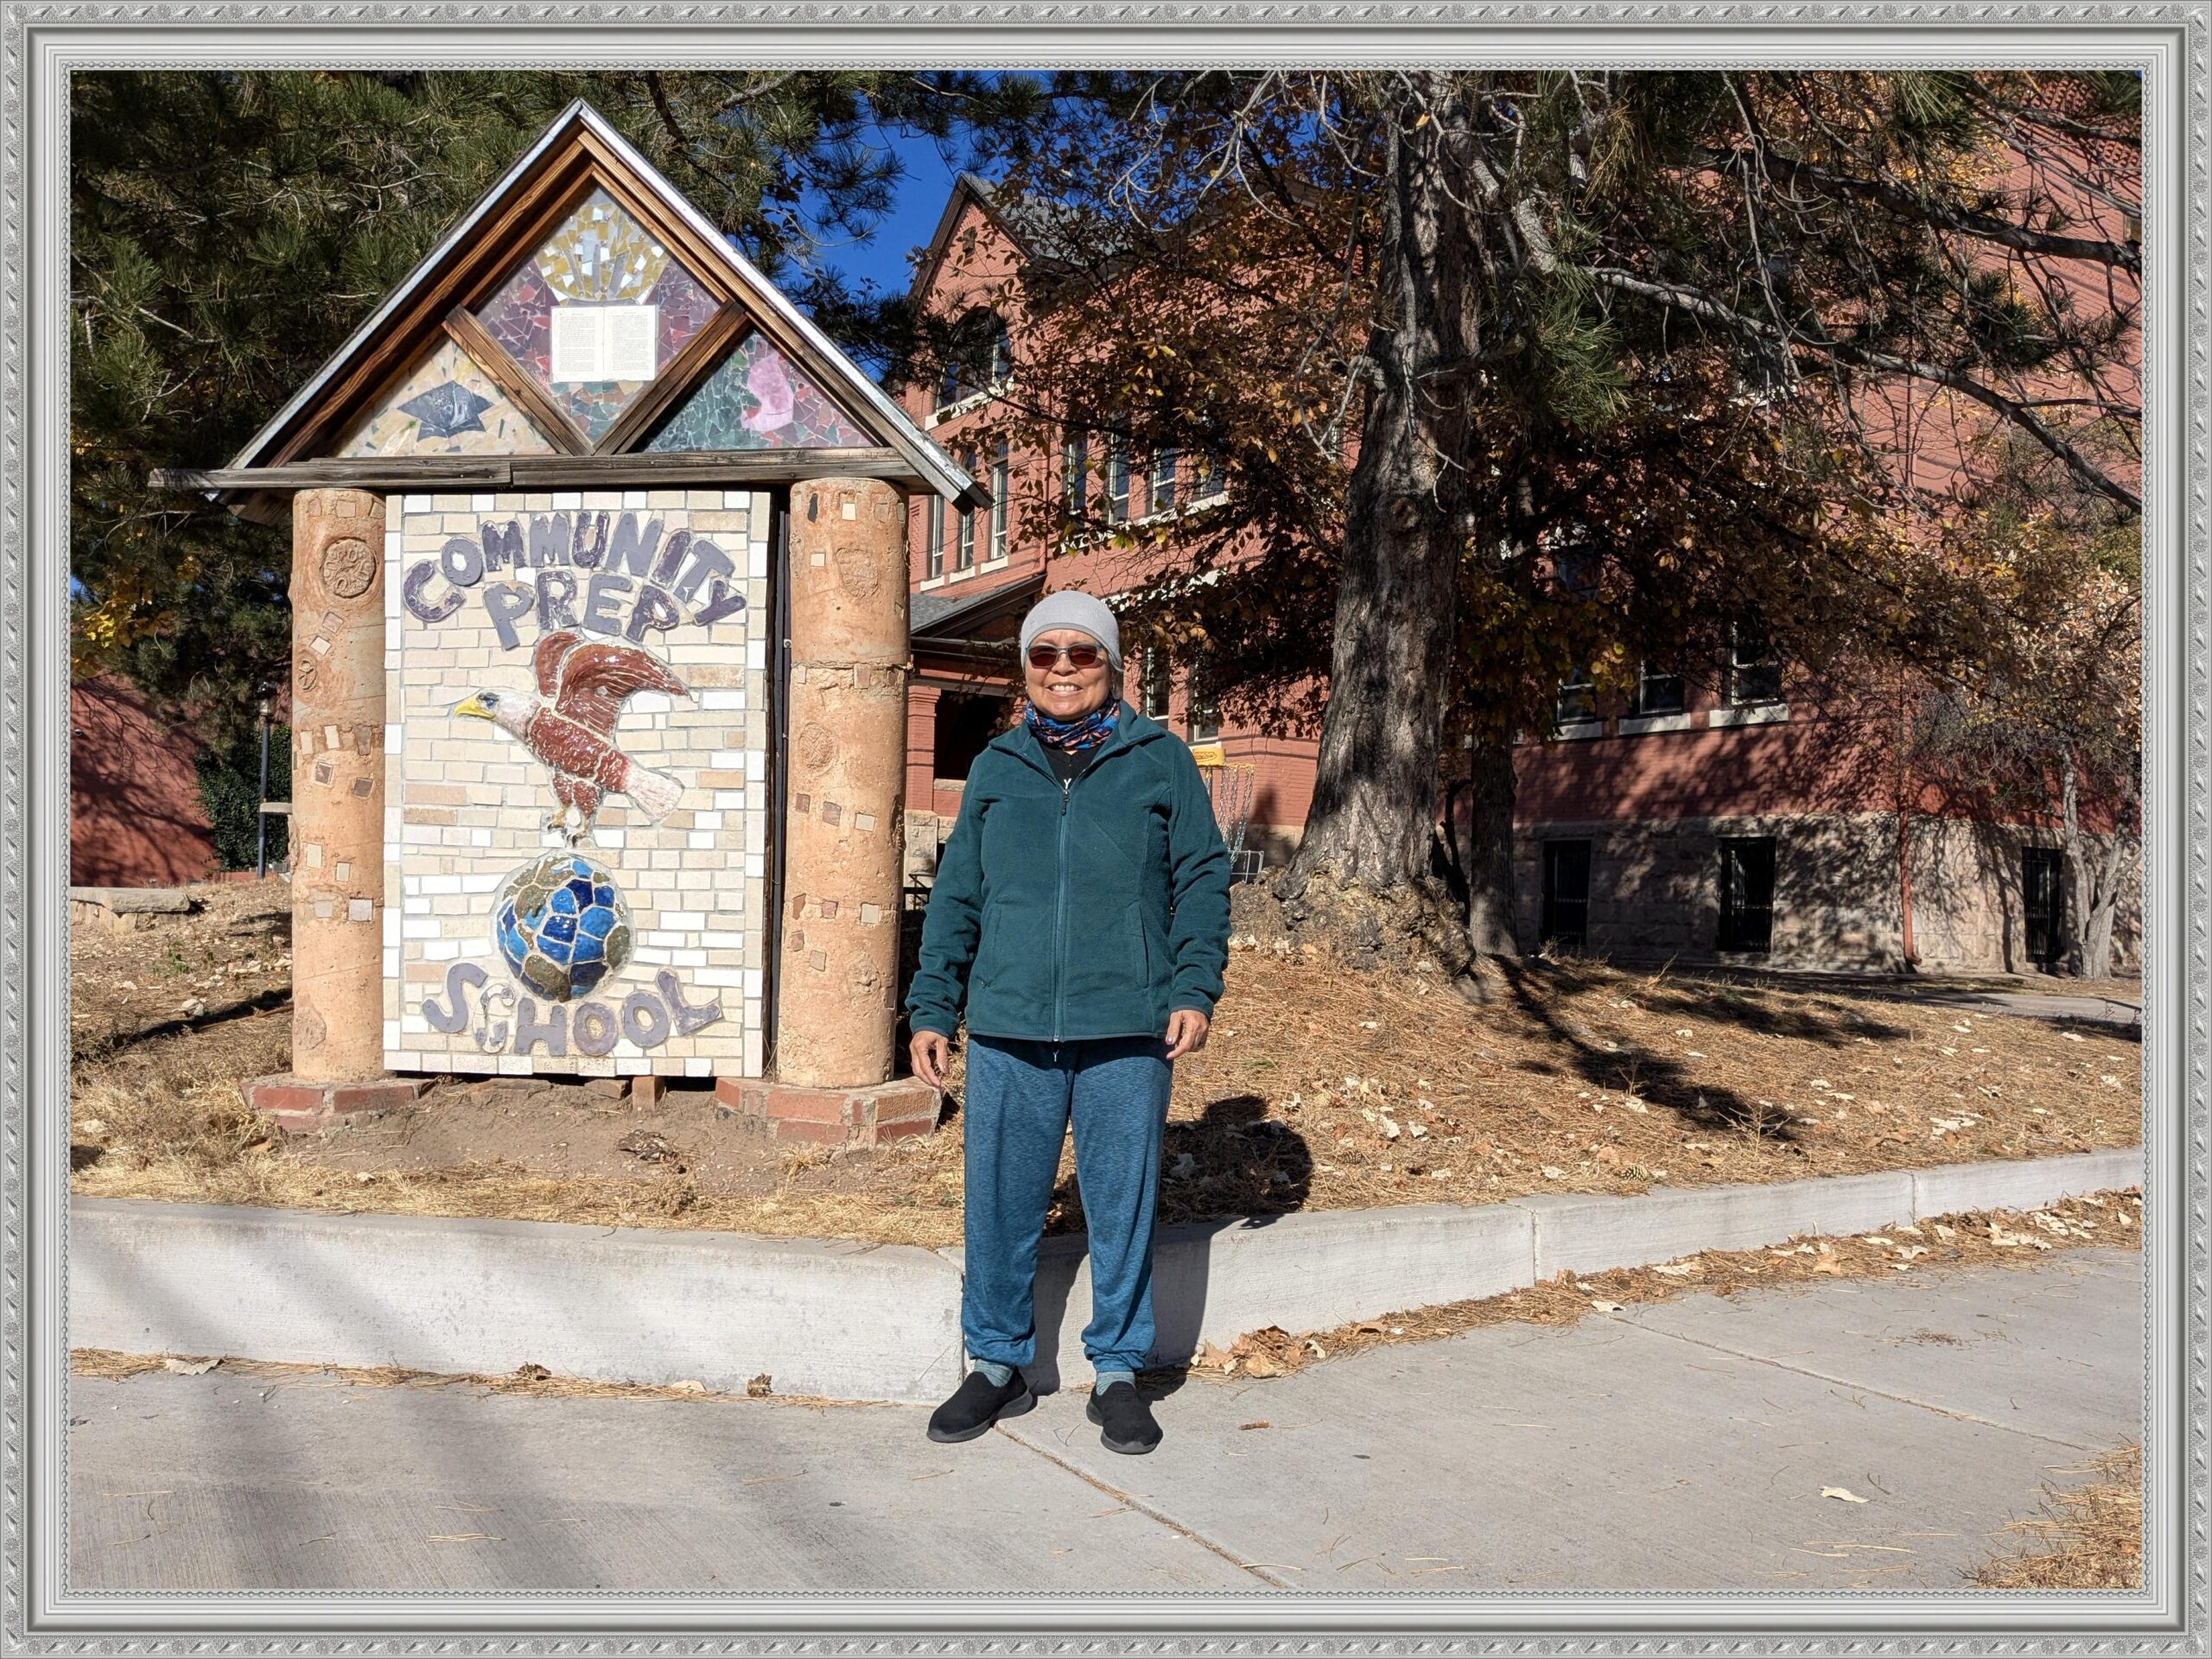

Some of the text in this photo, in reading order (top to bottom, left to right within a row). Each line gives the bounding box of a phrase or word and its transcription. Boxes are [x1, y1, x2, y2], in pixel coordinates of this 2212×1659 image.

[404, 511, 747, 626] COMMUNITY
[483, 570, 679, 650] PREP
[422, 963, 721, 1056] SCHOOL
